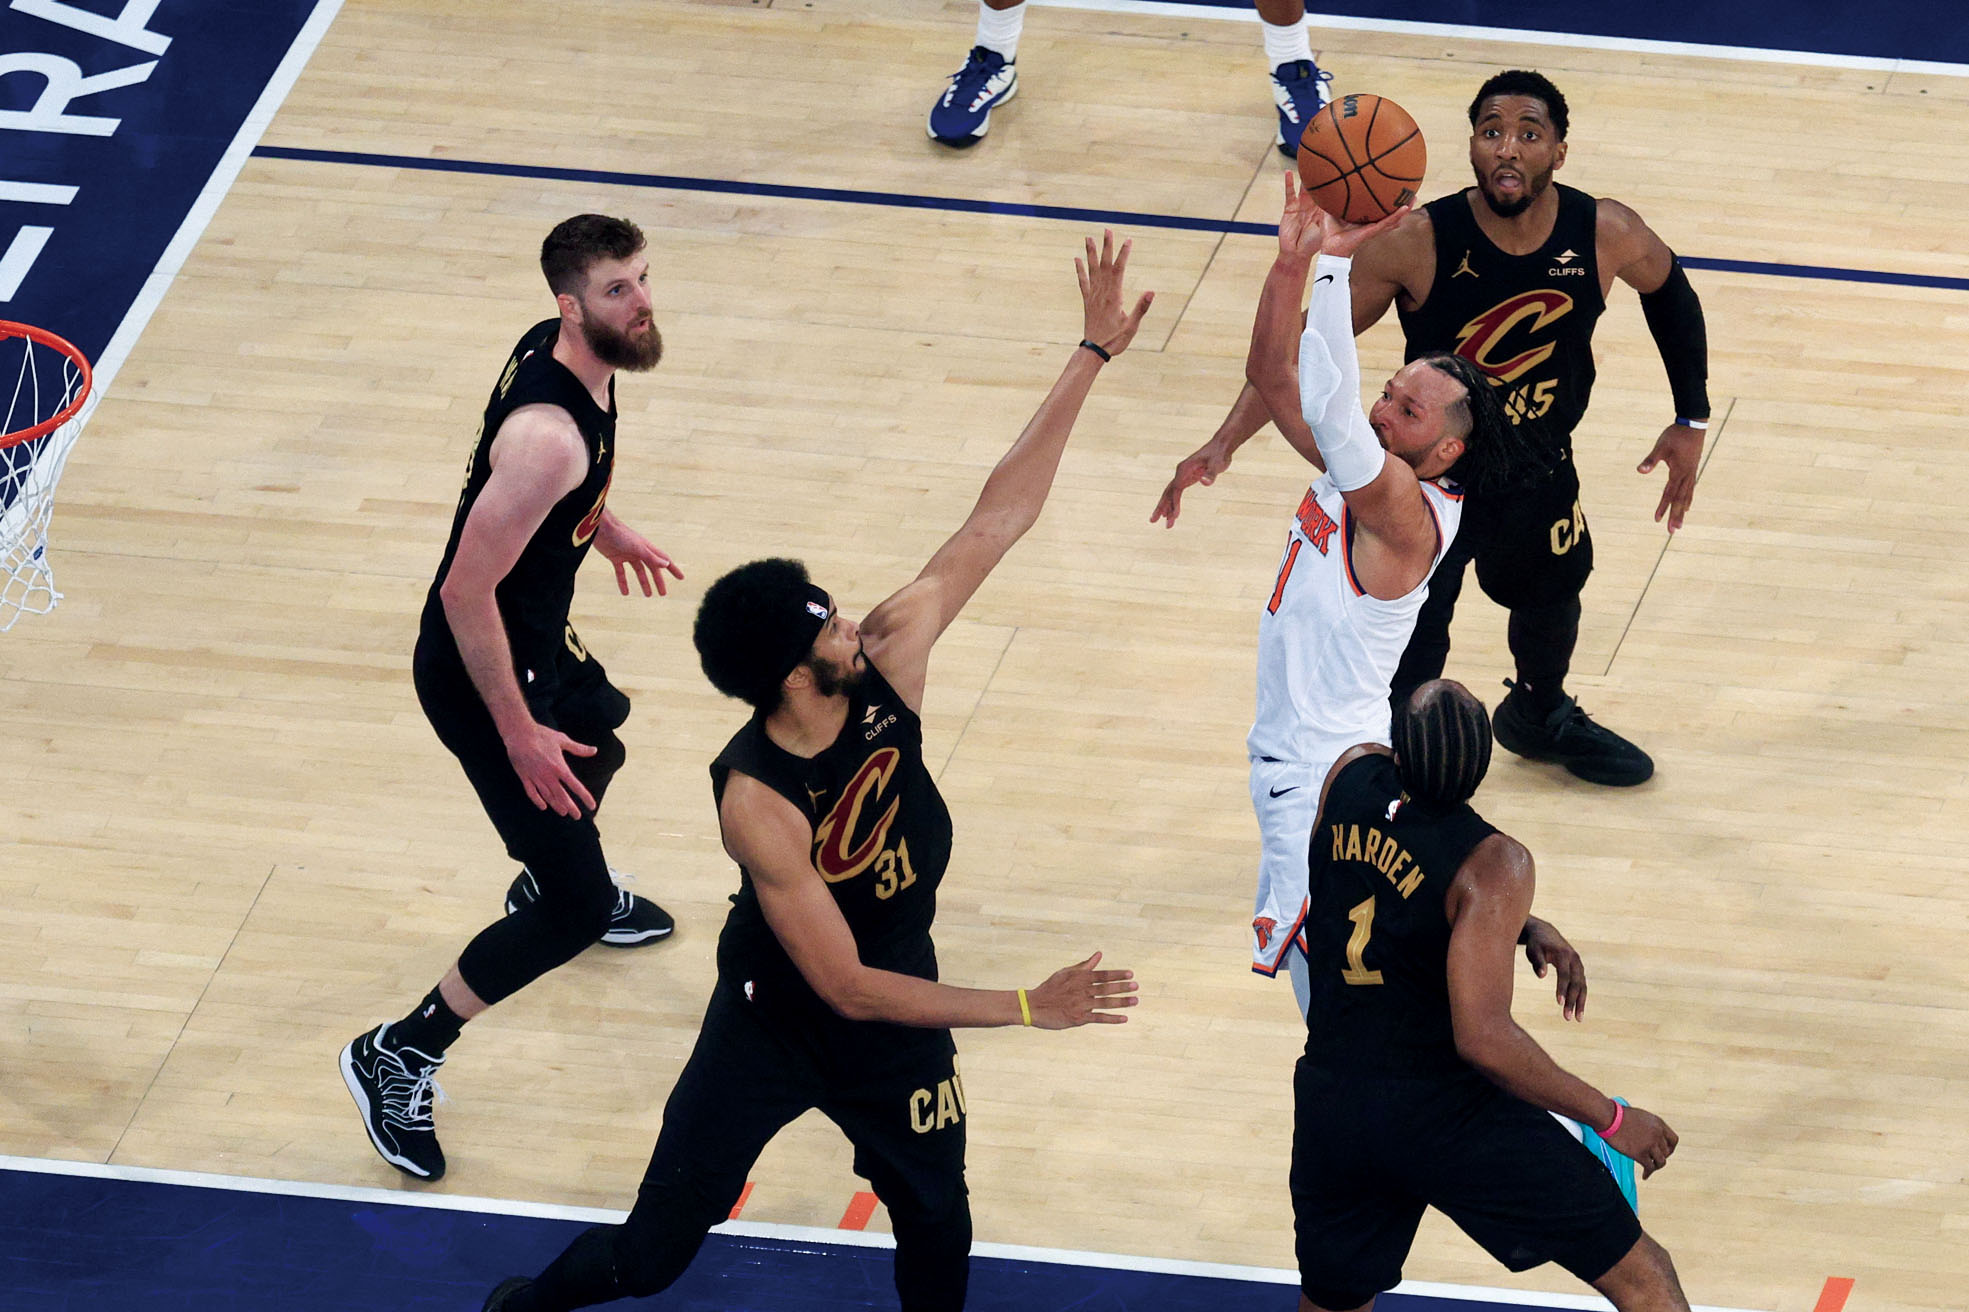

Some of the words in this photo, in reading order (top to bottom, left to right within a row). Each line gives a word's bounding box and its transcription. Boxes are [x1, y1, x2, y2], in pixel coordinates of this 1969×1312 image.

[1548, 267, 1585, 277] CLIFFS
[865, 714, 897, 741] CLIFFS
[814, 747, 900, 883] C
[874, 835, 917, 900] 31
[1331, 823, 1425, 900] HARDEN
[1341, 894, 1384, 985] 1
